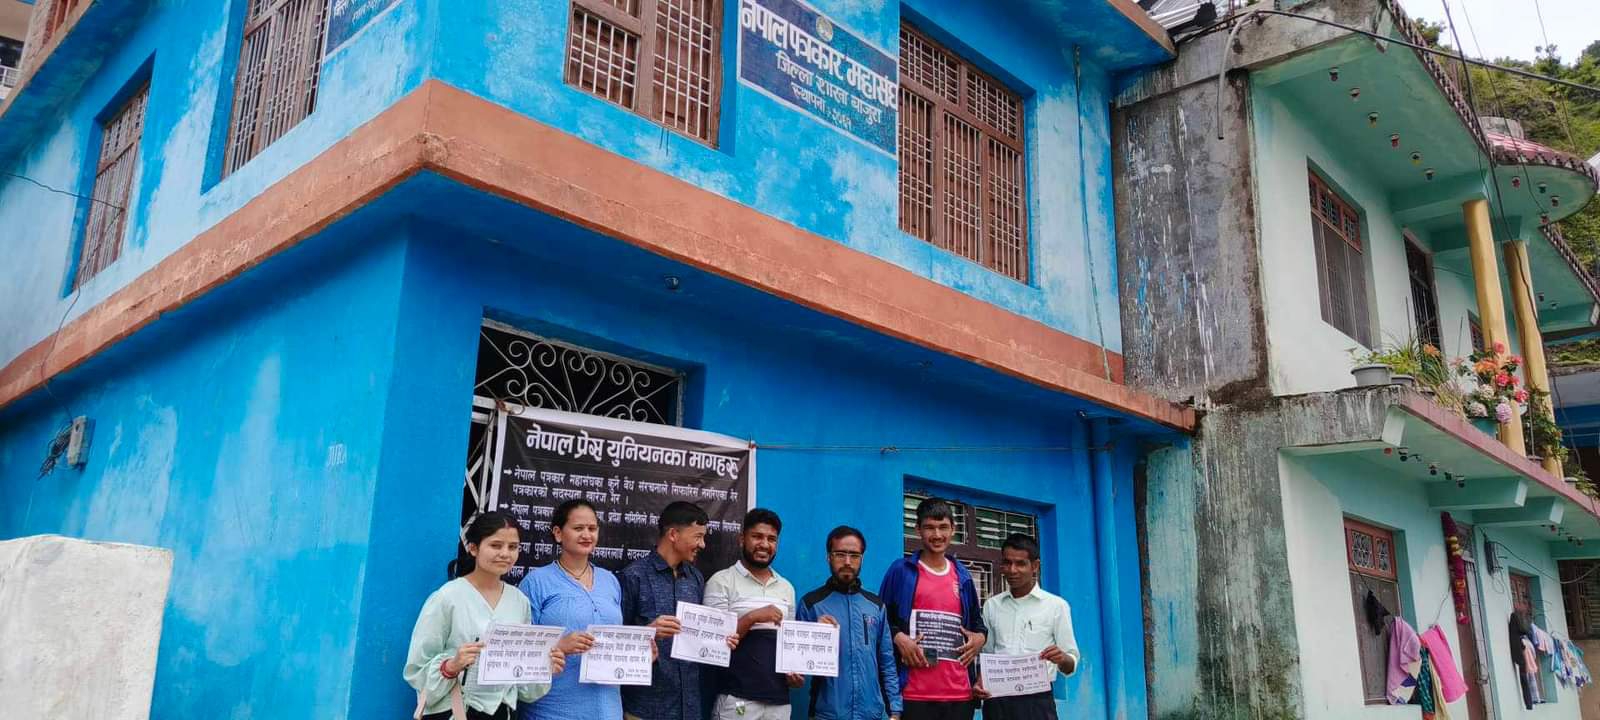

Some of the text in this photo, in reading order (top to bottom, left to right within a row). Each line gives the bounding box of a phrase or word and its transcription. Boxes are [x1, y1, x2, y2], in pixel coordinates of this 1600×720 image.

[789, 22, 845, 80] पत्रकार
[776, 52, 814, 86] जिल्ला
[815, 75, 848, 105] शाखा
[791, 82, 826, 112] स्थापना
[526, 423, 575, 455] नेपाल
[574, 430, 605, 462] प्रेस
[606, 436, 688, 467] युनियनका
[514, 465, 536, 481] नेपाल
[540, 471, 566, 484] पत्रकार
[512, 483, 548, 498] पत्रकारको
[552, 488, 582, 501] सदस्यता
[511, 500, 530, 516] नेपाल
